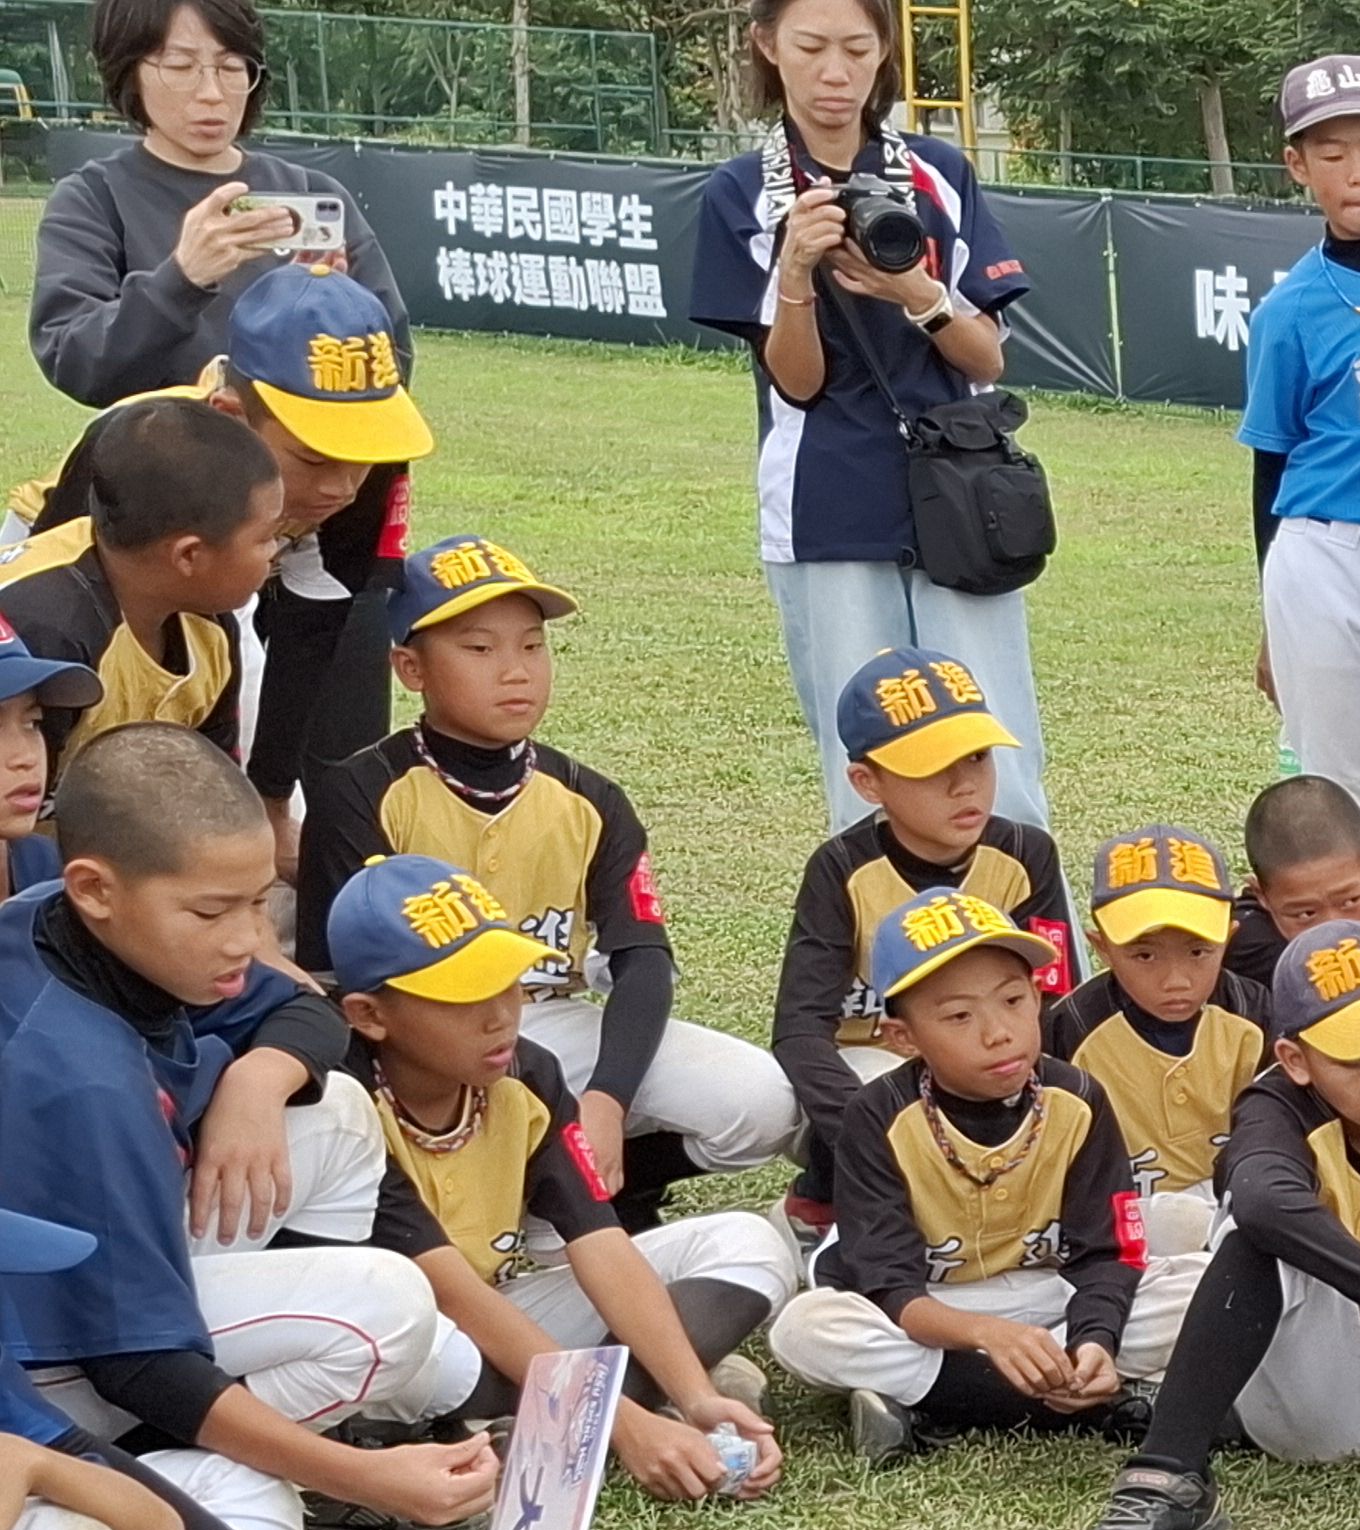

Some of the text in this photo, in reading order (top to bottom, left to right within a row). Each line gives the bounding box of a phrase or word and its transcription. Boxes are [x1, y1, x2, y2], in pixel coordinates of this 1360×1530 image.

[434, 181, 658, 250] 中華民國學生
[437, 247, 667, 318] 棒球運動聯盟
[1106, 837, 1222, 892] 新進
